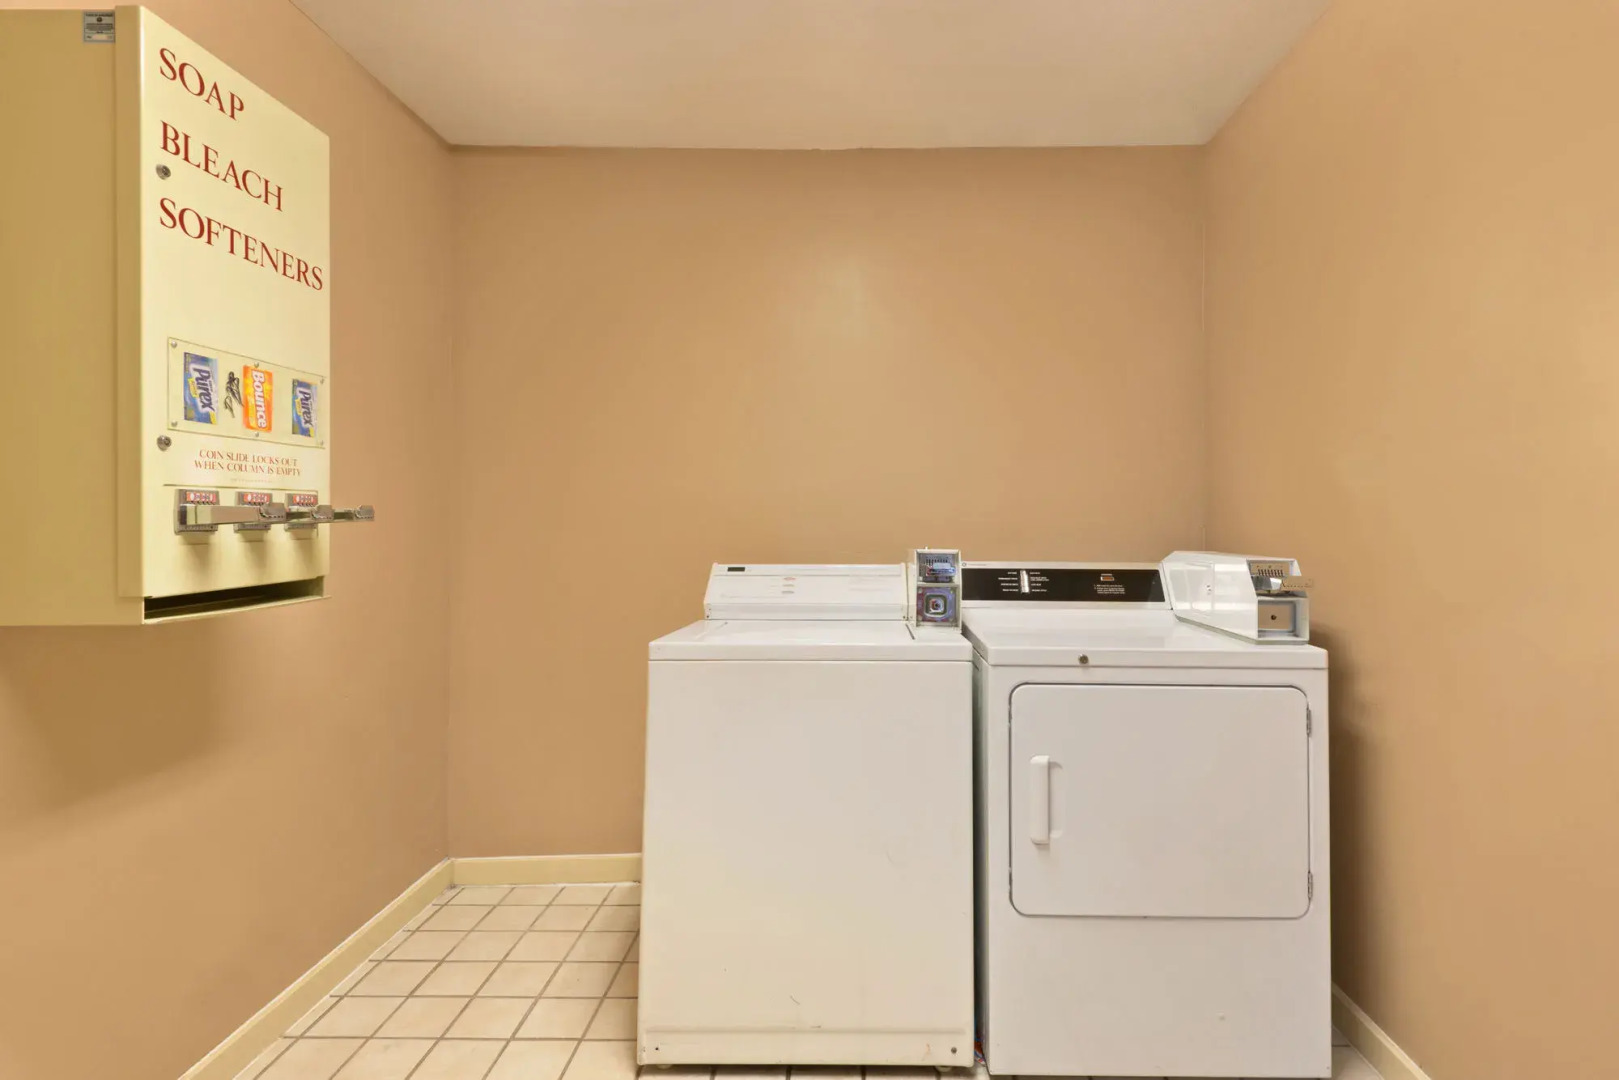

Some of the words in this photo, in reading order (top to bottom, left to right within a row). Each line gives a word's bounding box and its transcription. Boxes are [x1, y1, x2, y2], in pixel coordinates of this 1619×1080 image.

[159, 47, 244, 120] SOAP
[160, 120, 283, 211] BLEACH
[159, 197, 323, 290] SOFTENERS
[192, 367, 215, 412] Purex
[252, 369, 267, 429] Bounce
[298, 390, 313, 427] Purex
[194, 460, 224, 470] WHEN
[226, 463, 265, 474] COLUMN
[267, 466, 274, 474] IS
[276, 467, 301, 476] EMPTY
[199, 449, 224, 459] COIN
[226, 452, 249, 461] SLIDE
[252, 454, 279, 464] LOCKS
[281, 457, 298, 466] OUT
